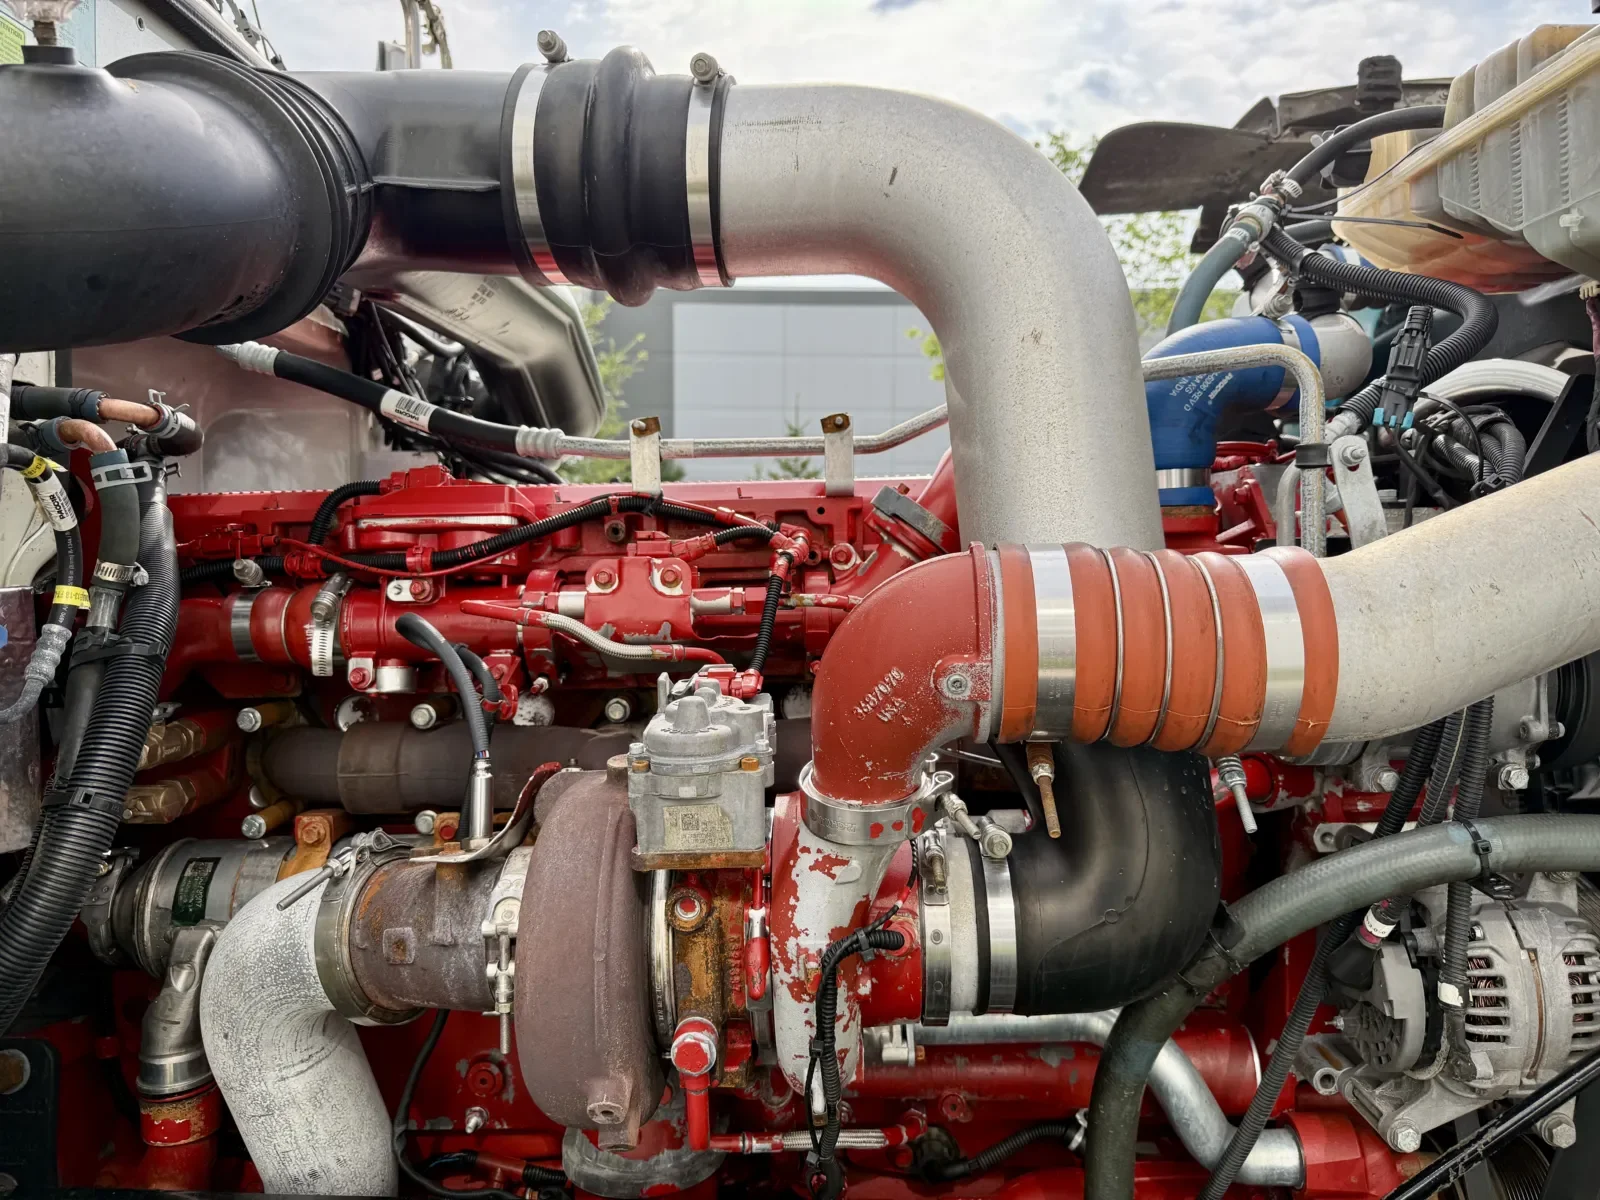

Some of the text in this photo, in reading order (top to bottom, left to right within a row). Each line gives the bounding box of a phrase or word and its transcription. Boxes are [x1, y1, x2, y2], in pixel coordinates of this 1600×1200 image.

[1169, 376, 1189, 397] INDIA
[1189, 389, 1203, 407] REV
[875, 696, 907, 723] USA
